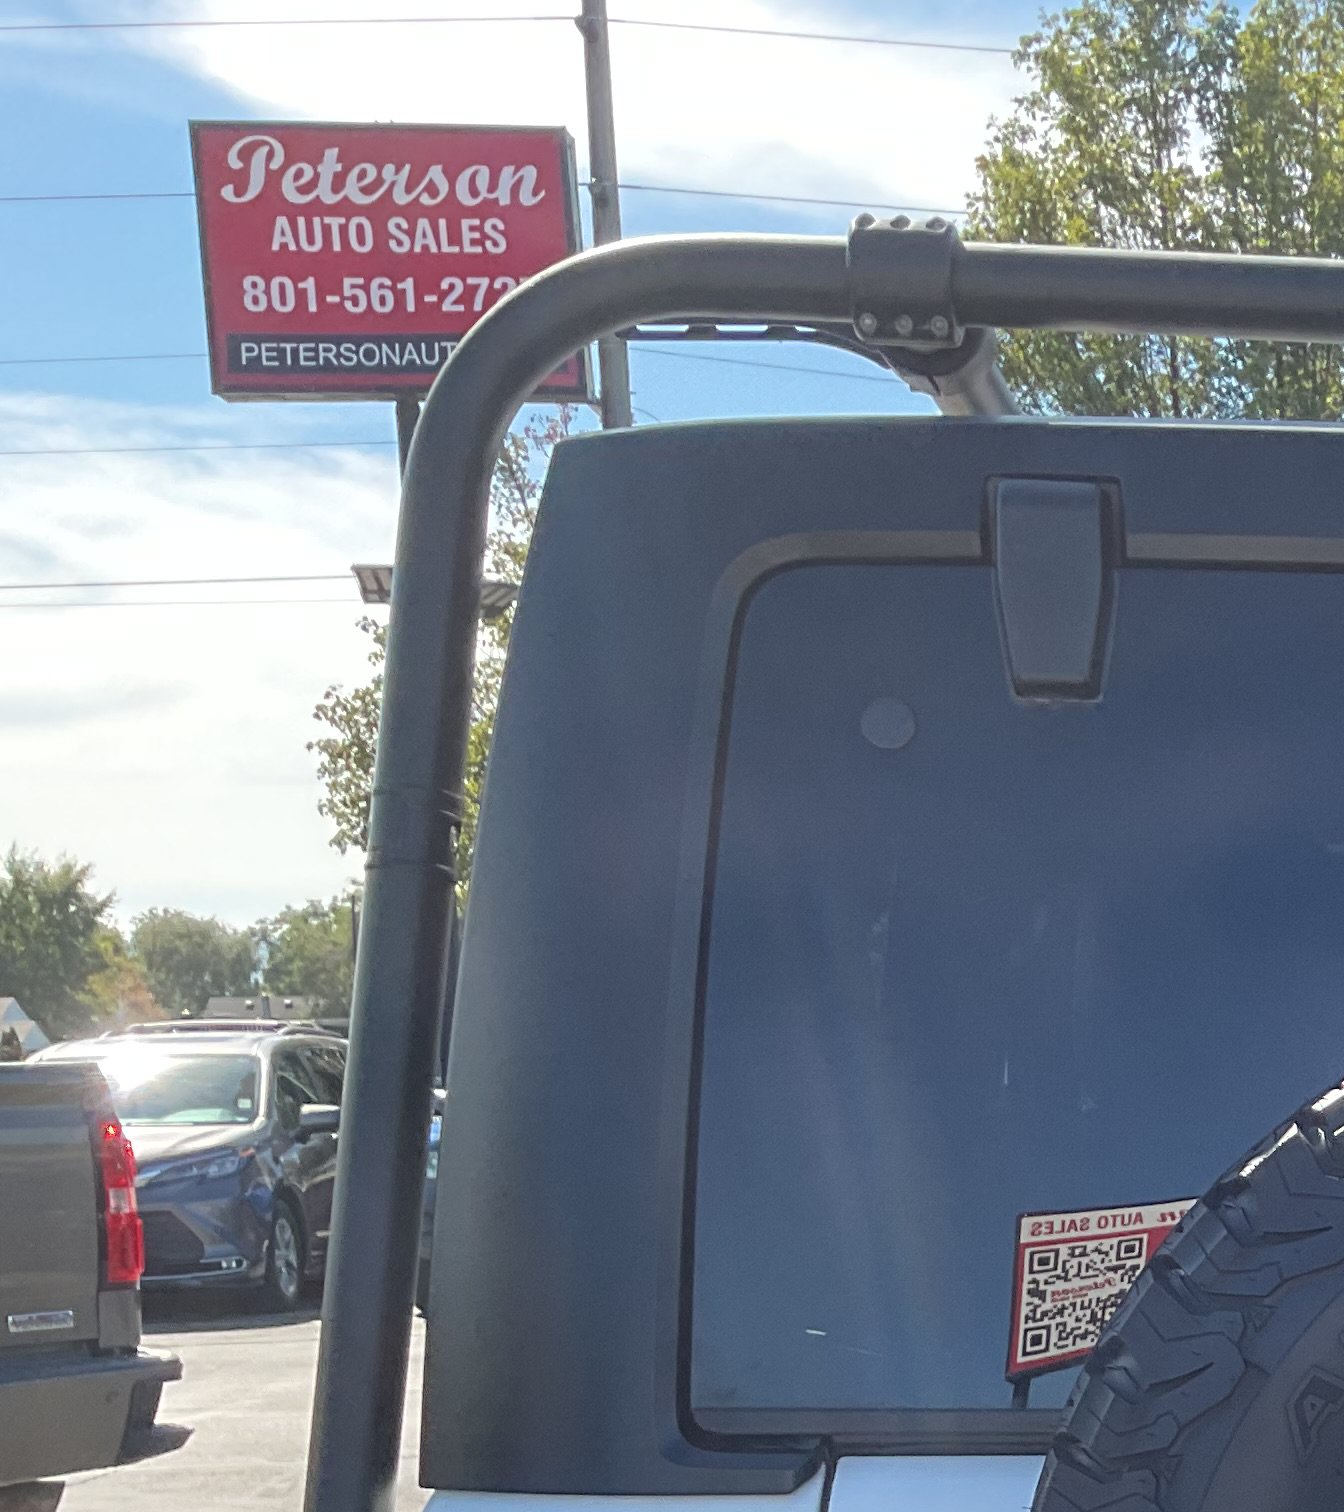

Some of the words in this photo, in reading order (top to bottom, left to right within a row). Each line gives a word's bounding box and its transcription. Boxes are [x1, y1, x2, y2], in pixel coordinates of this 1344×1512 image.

[220, 134, 546, 207] Peterson
[271, 216, 375, 253] AUTO
[388, 217, 508, 254] SALES
[242, 275, 529, 313] 801-561-272
[240, 341, 463, 367] PETERSONAUT
